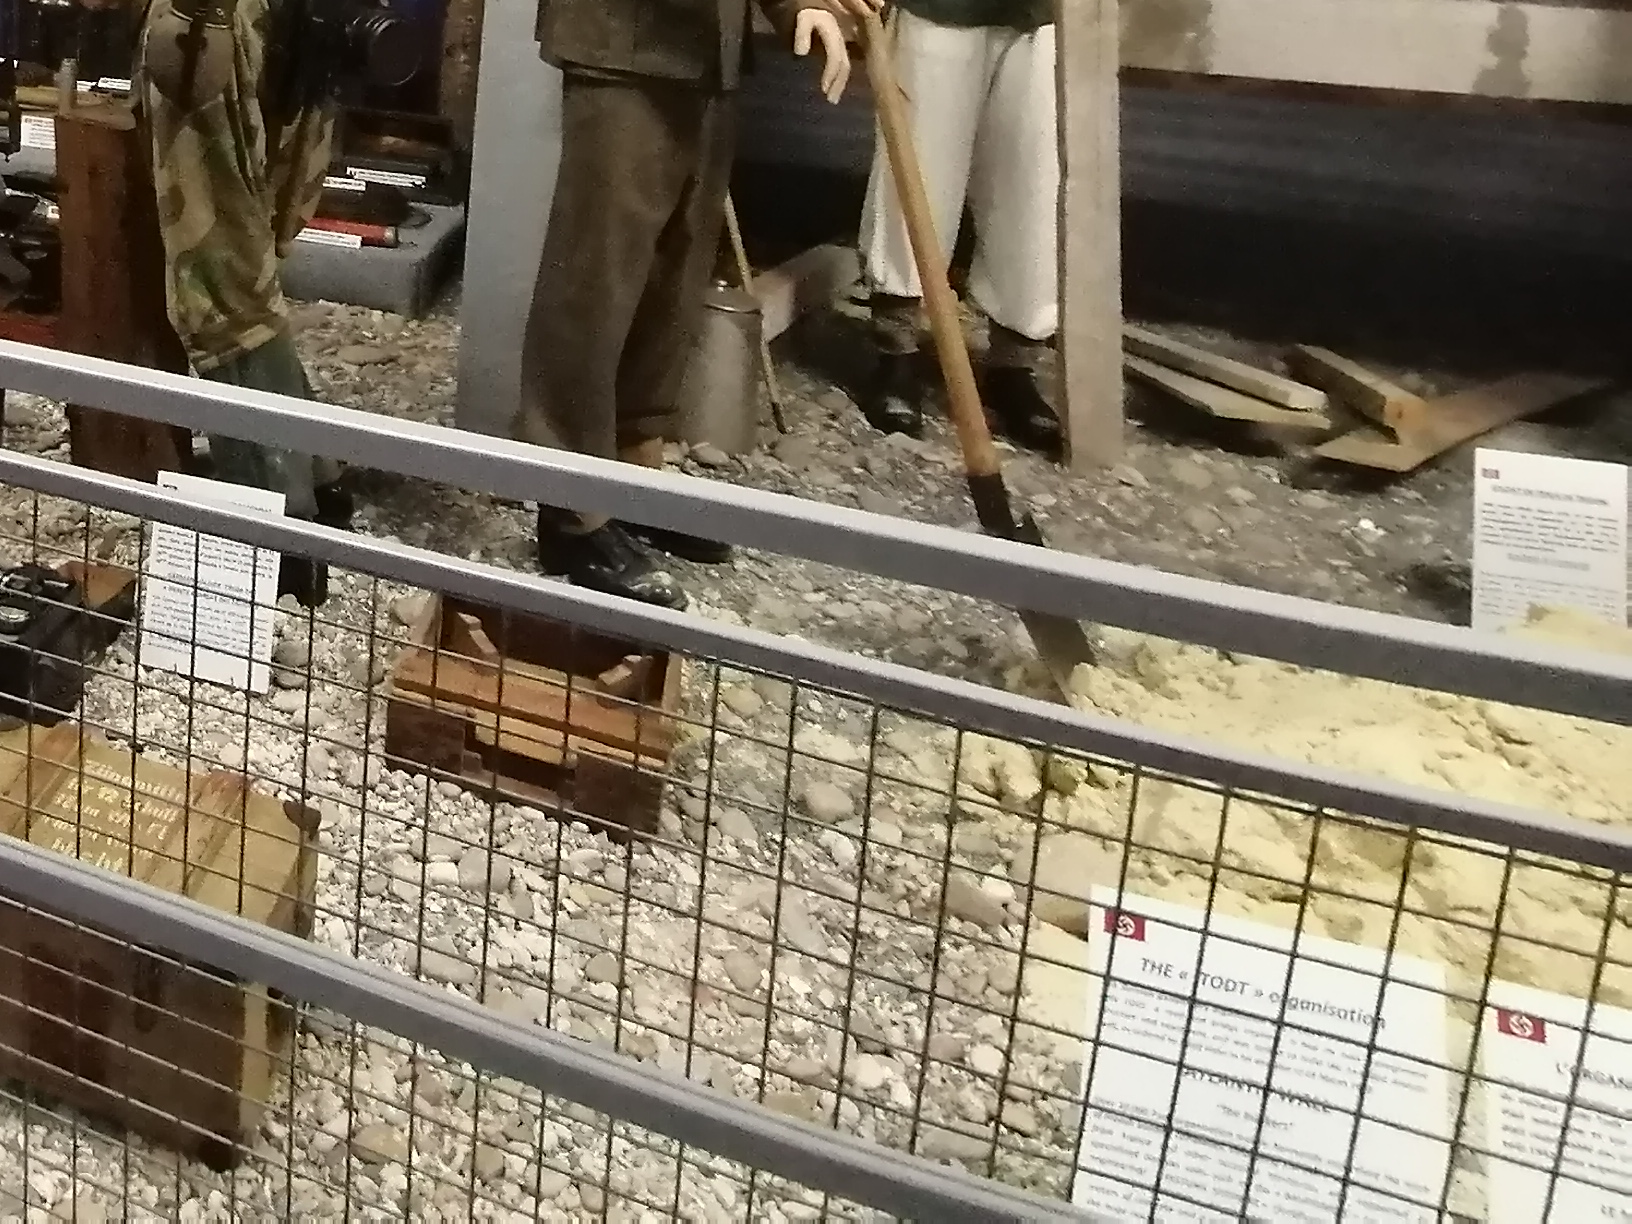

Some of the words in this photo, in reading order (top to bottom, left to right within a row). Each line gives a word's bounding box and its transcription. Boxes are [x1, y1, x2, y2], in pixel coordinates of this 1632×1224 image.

[1142, 957, 1174, 979] THE
[1200, 971, 1251, 995] TODT
[1269, 991, 1386, 1030] oganisation
